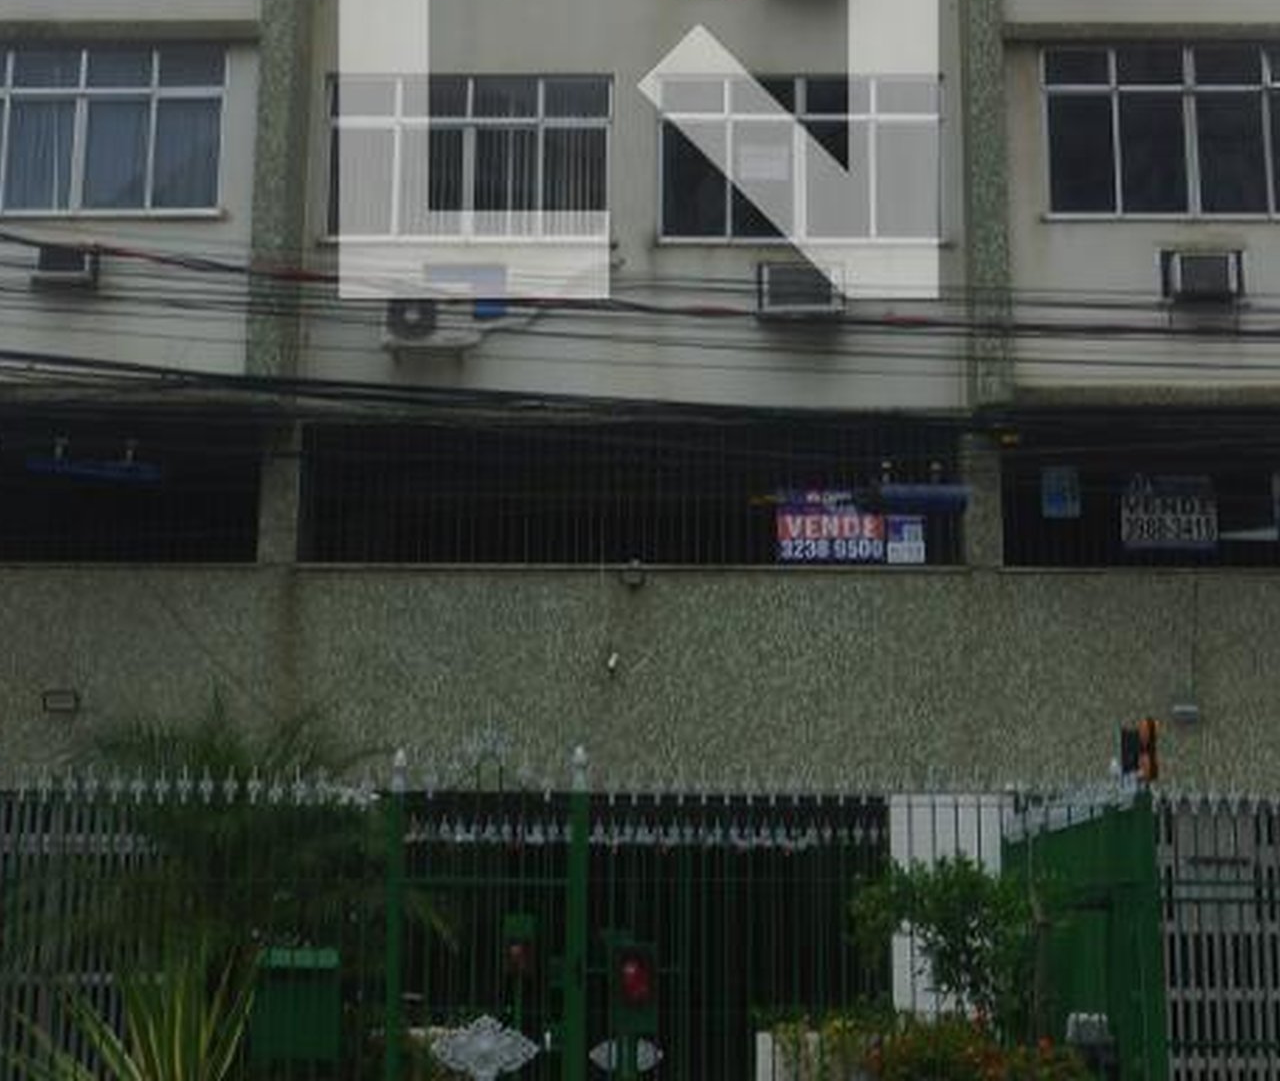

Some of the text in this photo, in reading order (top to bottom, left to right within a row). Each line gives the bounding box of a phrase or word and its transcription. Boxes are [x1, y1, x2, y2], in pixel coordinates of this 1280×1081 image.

[784, 515, 877, 538] VENDE
[781, 539, 829, 559] 3238
[833, 539, 883, 559] 9500
